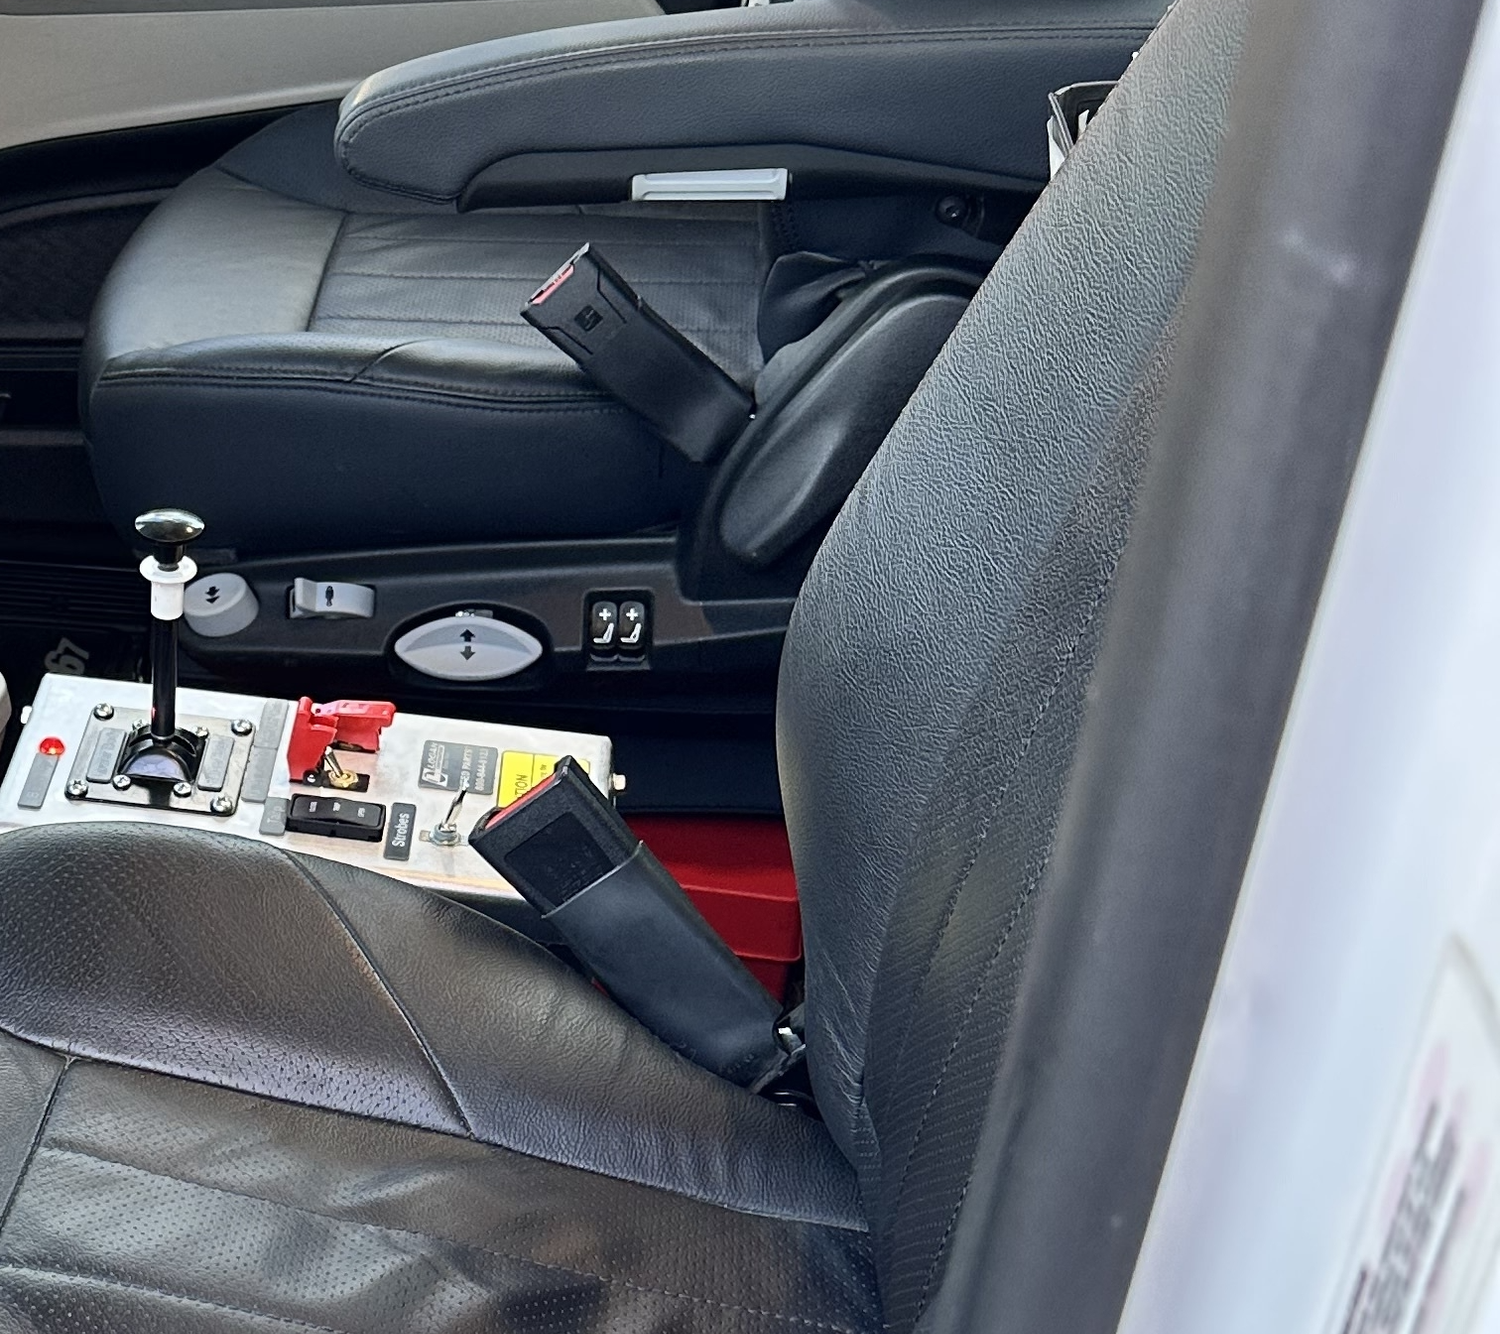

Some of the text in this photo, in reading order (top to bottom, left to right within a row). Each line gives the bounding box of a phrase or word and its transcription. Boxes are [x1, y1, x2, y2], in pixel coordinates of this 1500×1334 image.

[44, 637, 90, 675] 67
[426, 741, 438, 769] LOGAN
[391, 811, 411, 848] Strobes
